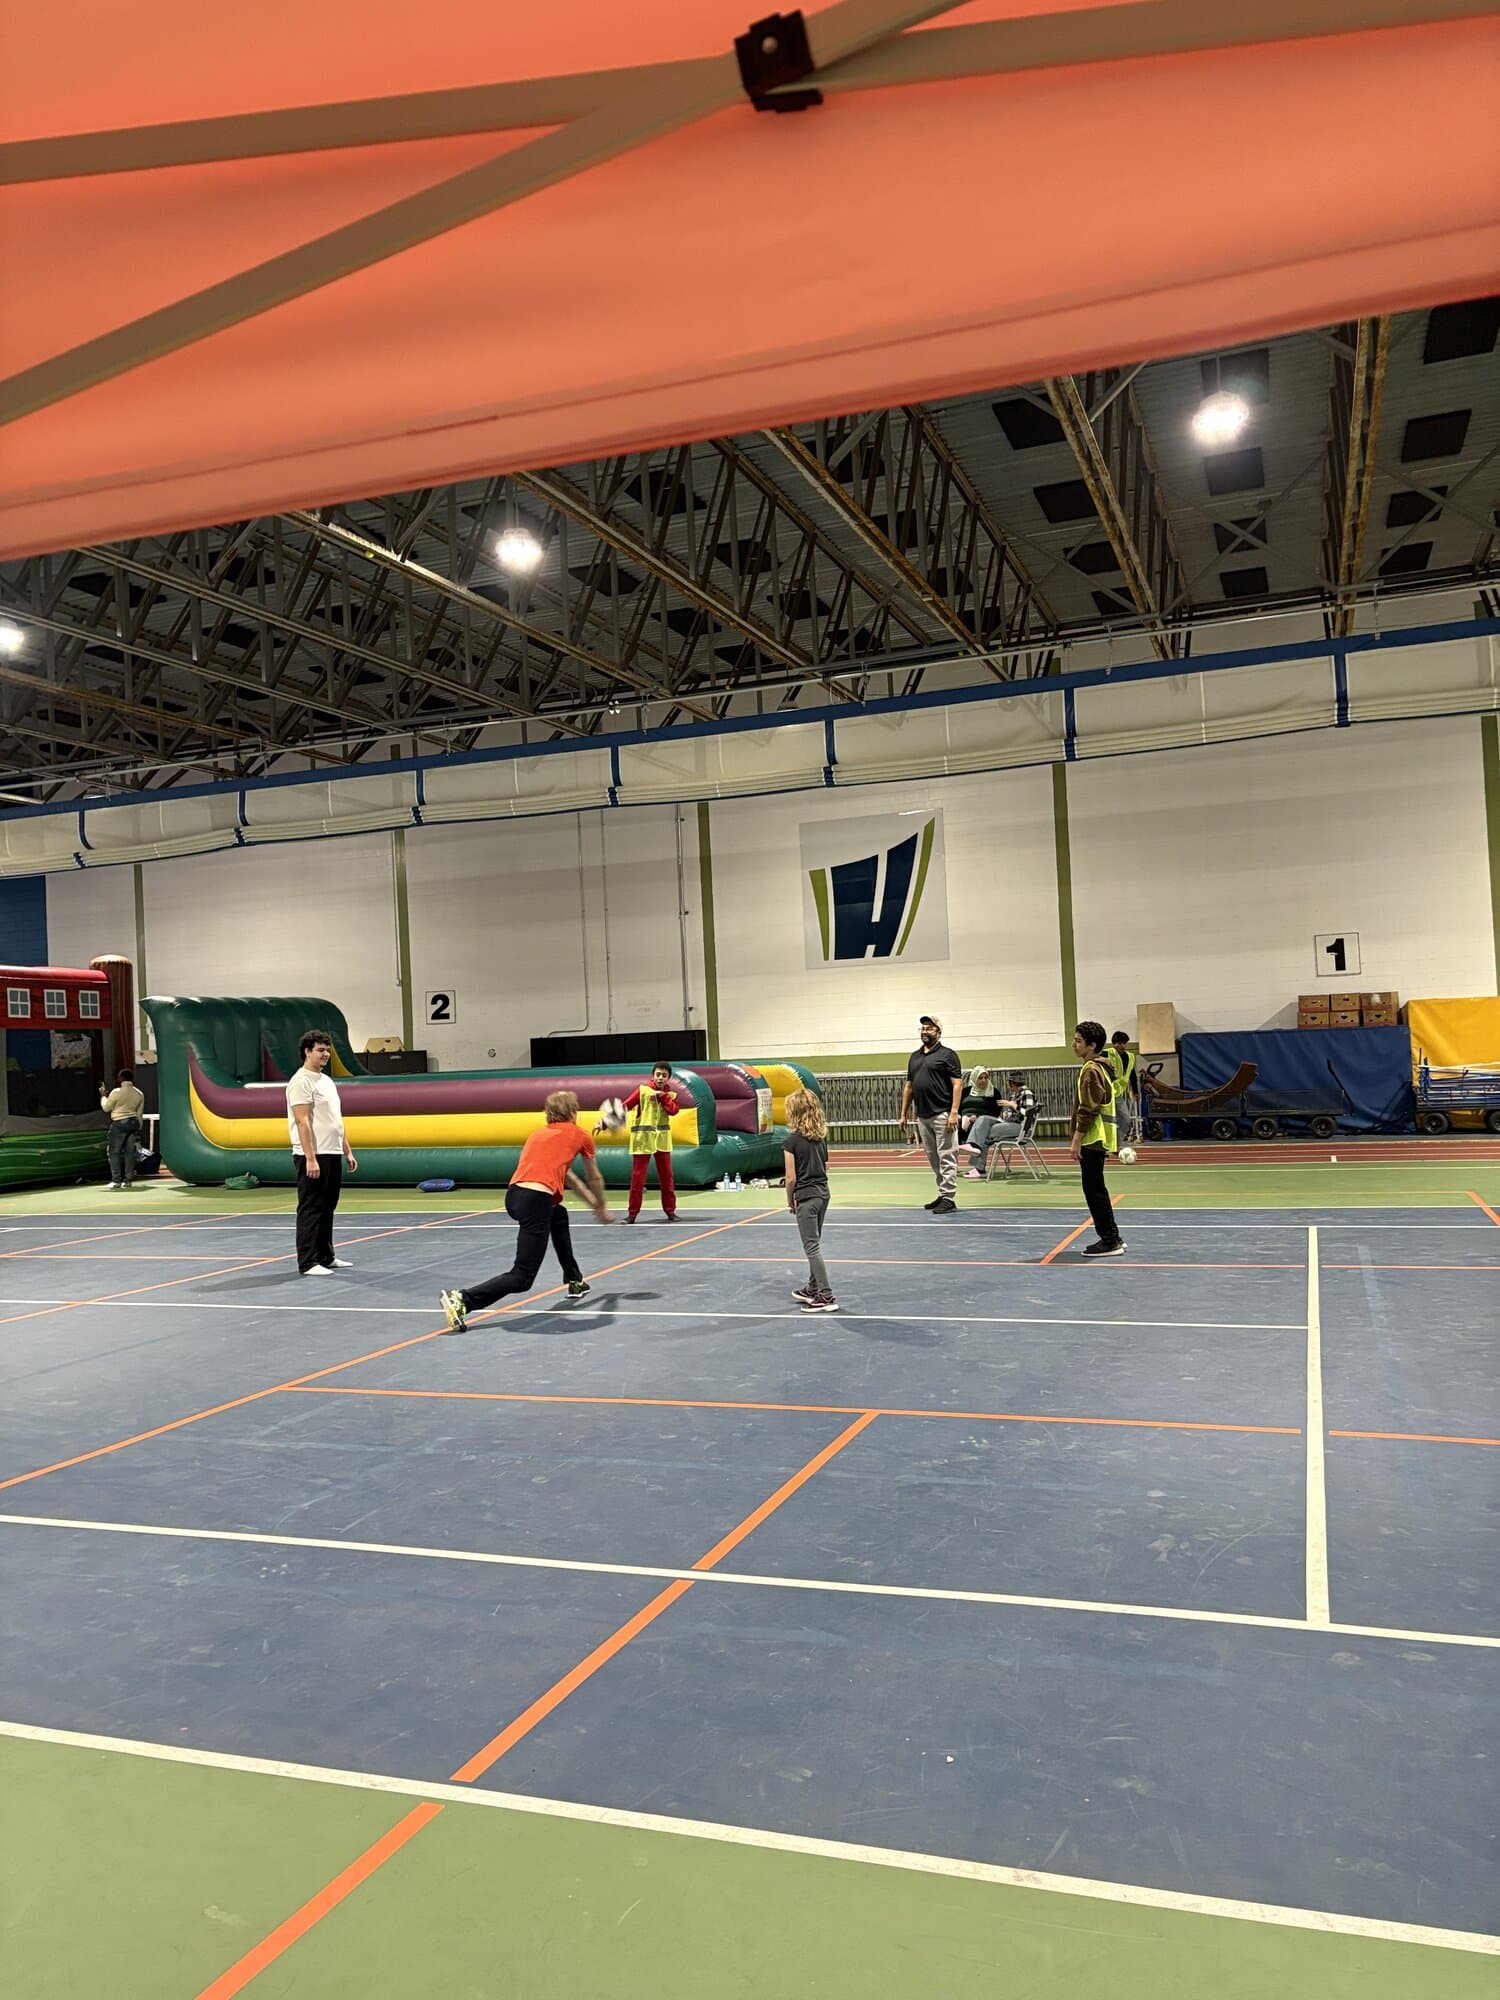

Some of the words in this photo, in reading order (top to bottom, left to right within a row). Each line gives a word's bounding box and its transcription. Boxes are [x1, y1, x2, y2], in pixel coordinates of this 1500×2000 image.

[830, 832, 919, 961] H
[1326, 938, 1346, 971] 1
[431, 994, 450, 1020] 2
